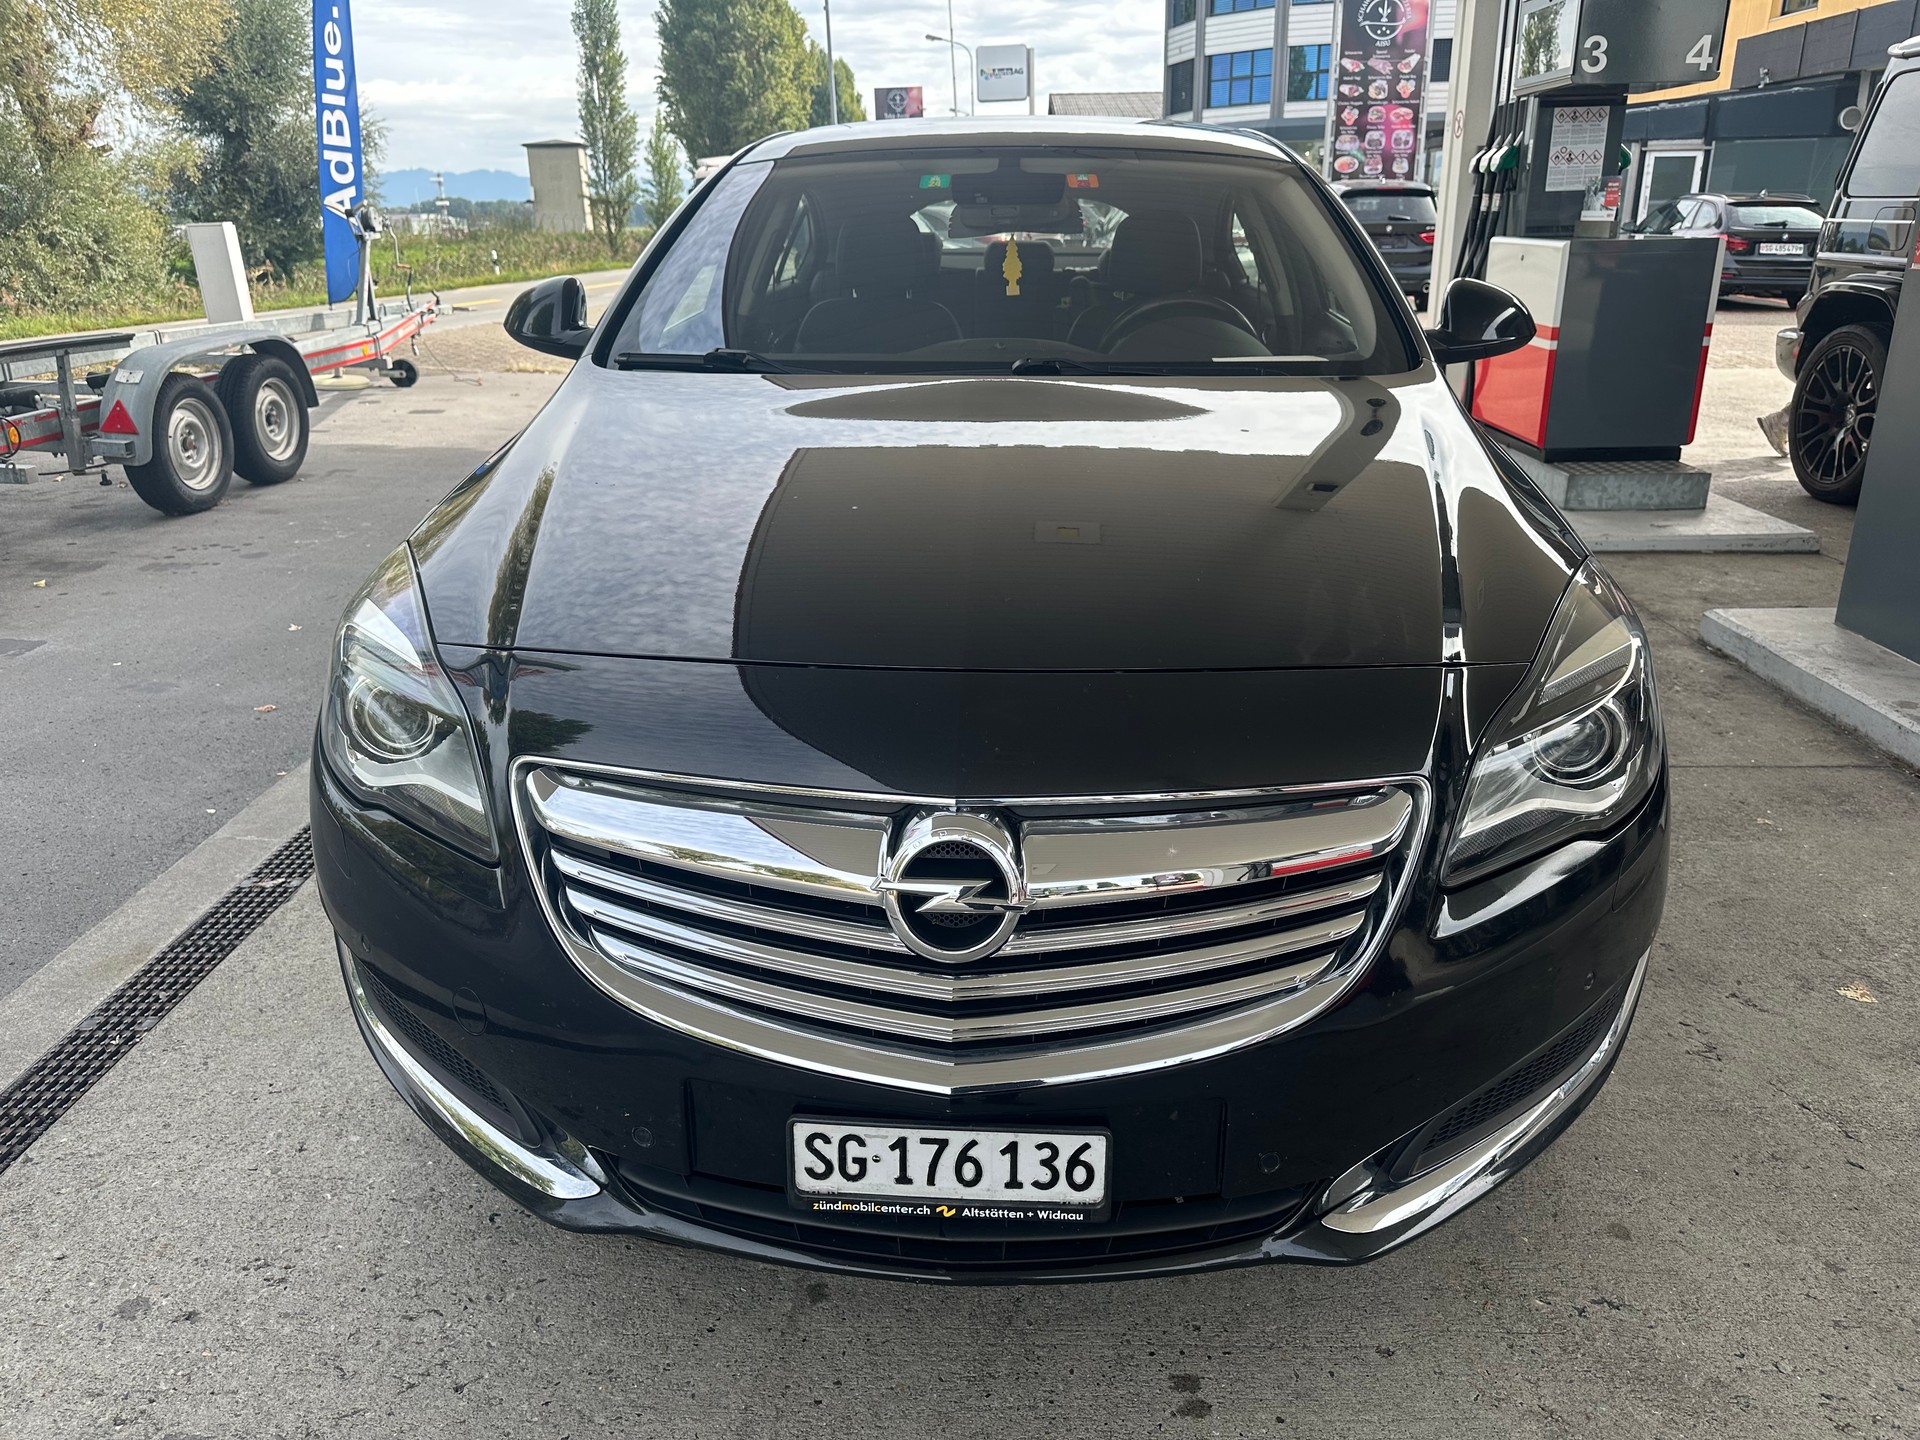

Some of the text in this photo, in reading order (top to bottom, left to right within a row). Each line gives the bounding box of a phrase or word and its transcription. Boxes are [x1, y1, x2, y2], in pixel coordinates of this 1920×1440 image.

[1580, 35, 1608, 74] 3
[1685, 34, 1713, 72] 4
[804, 1131, 1096, 1193] SG 176 136
[812, 1200, 931, 1216] zündmobilcenter.ch
[961, 1207, 1024, 1220] Altstätten
[1037, 1209, 1084, 1221] Widnau
